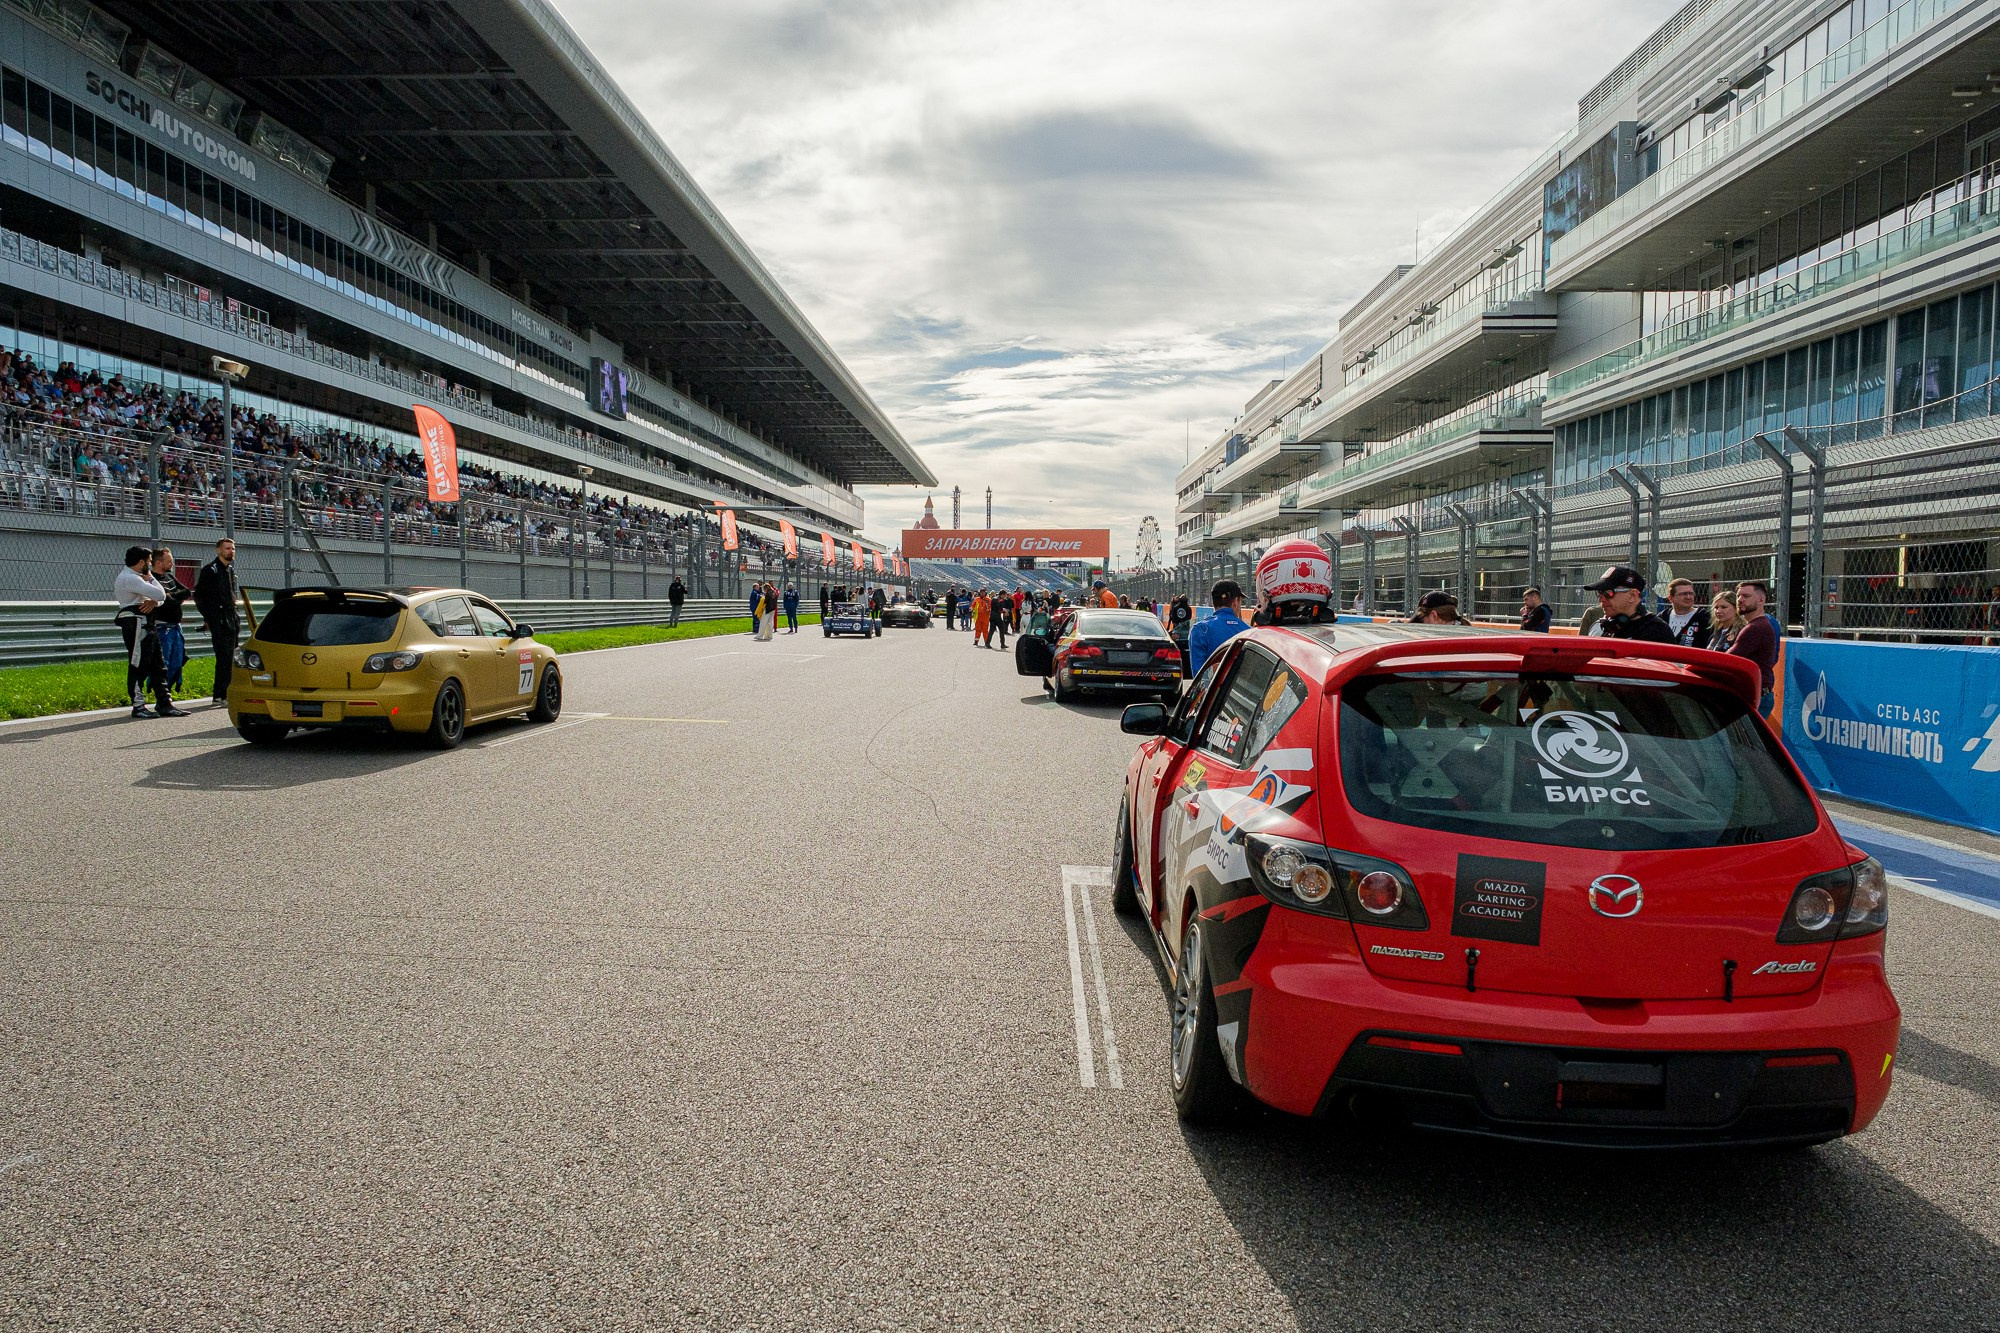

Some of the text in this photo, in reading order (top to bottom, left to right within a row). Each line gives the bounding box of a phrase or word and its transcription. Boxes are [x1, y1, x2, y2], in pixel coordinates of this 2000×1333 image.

[86, 71, 256, 182] SOCHI AUTODROM
[511, 307, 573, 352] MORE THAN RACING
[925, 537, 1017, 550] ЗАПРАВЛЕНО
[521, 669, 533, 689] 77
[1877, 703, 1940, 726] СЕТЬ АЗС
[1826, 717, 1944, 764] ГАЗПРОМНЕФТЬ
[1544, 785, 1651, 806] БИРСС
[1206, 838, 1229, 870] БИРСС
[1484, 881, 1526, 895] MAZDA
[1477, 894, 1526, 907] KARTING
[1468, 905, 1525, 919] ACADEMY
[1370, 945, 1445, 961] MAZDASPEED
[1752, 959, 1817, 975] Axela
